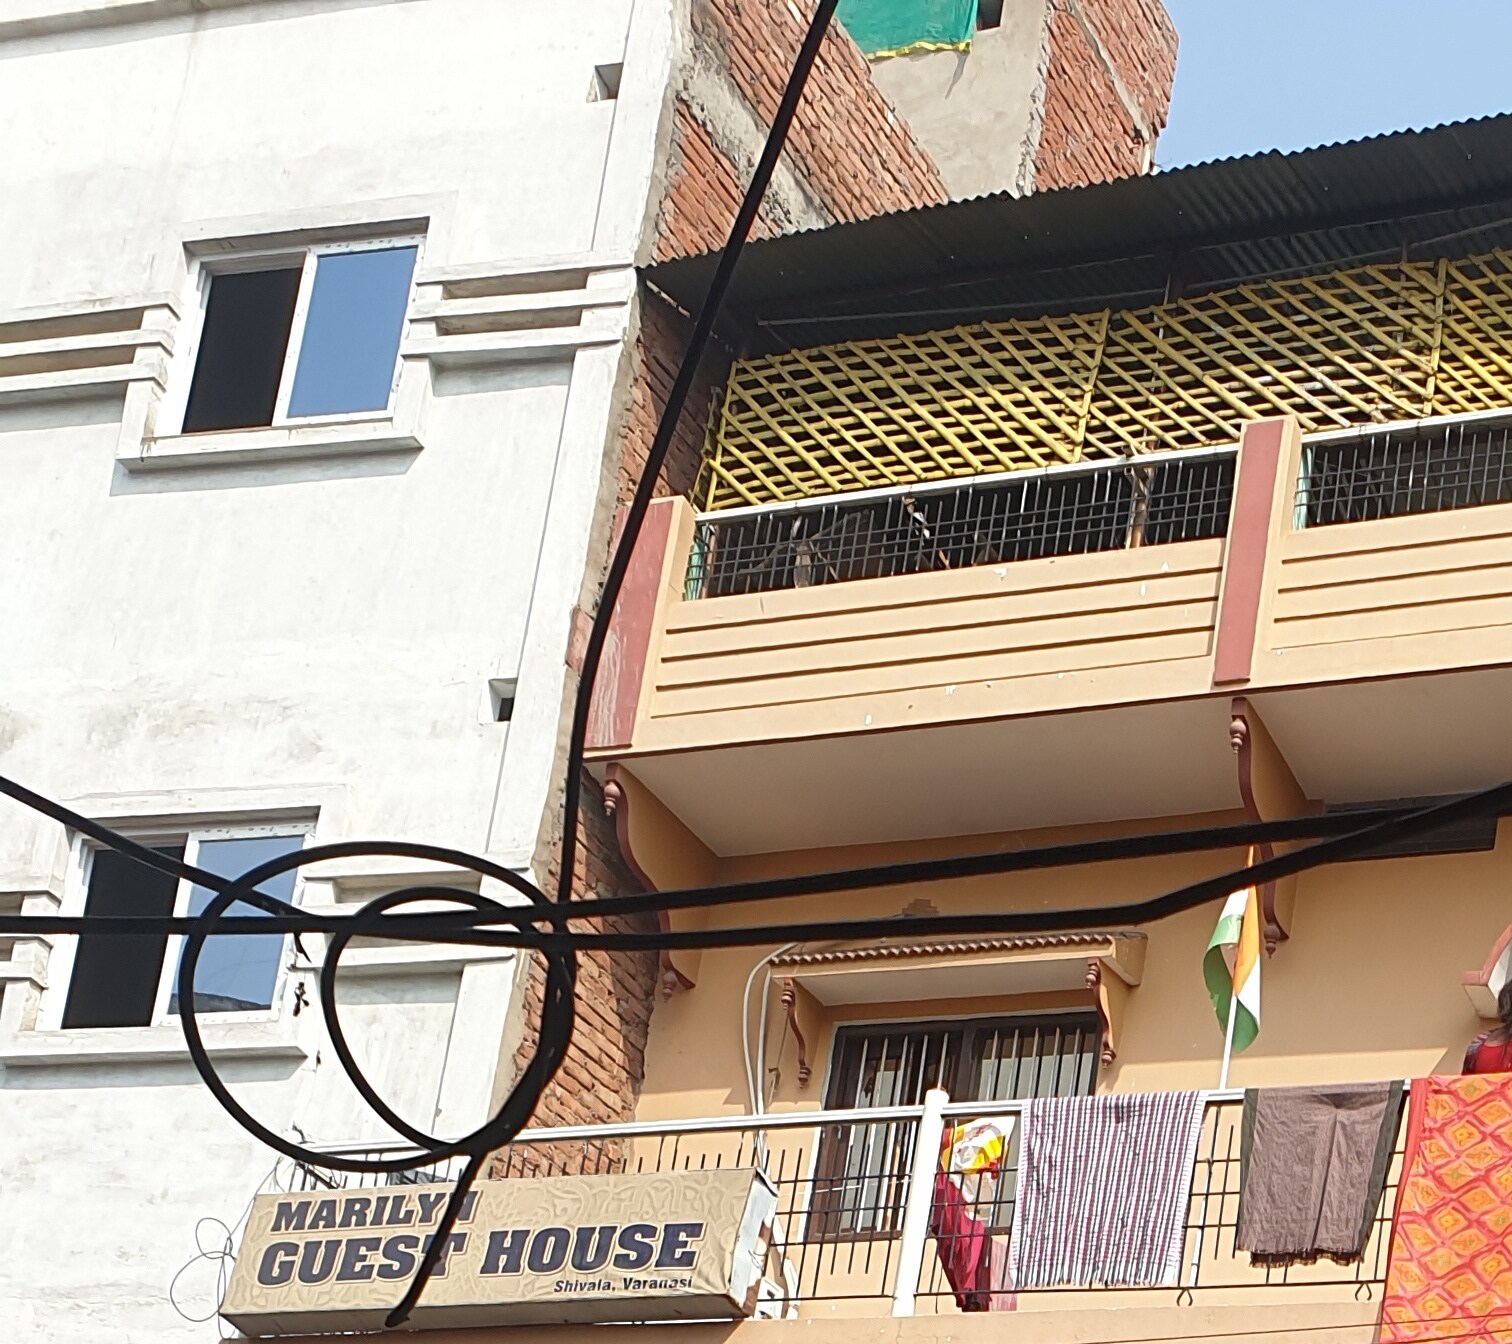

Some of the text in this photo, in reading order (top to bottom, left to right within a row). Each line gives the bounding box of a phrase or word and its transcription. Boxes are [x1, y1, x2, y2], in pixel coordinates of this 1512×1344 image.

[258, 1222, 704, 1285] GUEST HOUSE
[553, 1276, 693, 1294] Shivala, Varanasi
